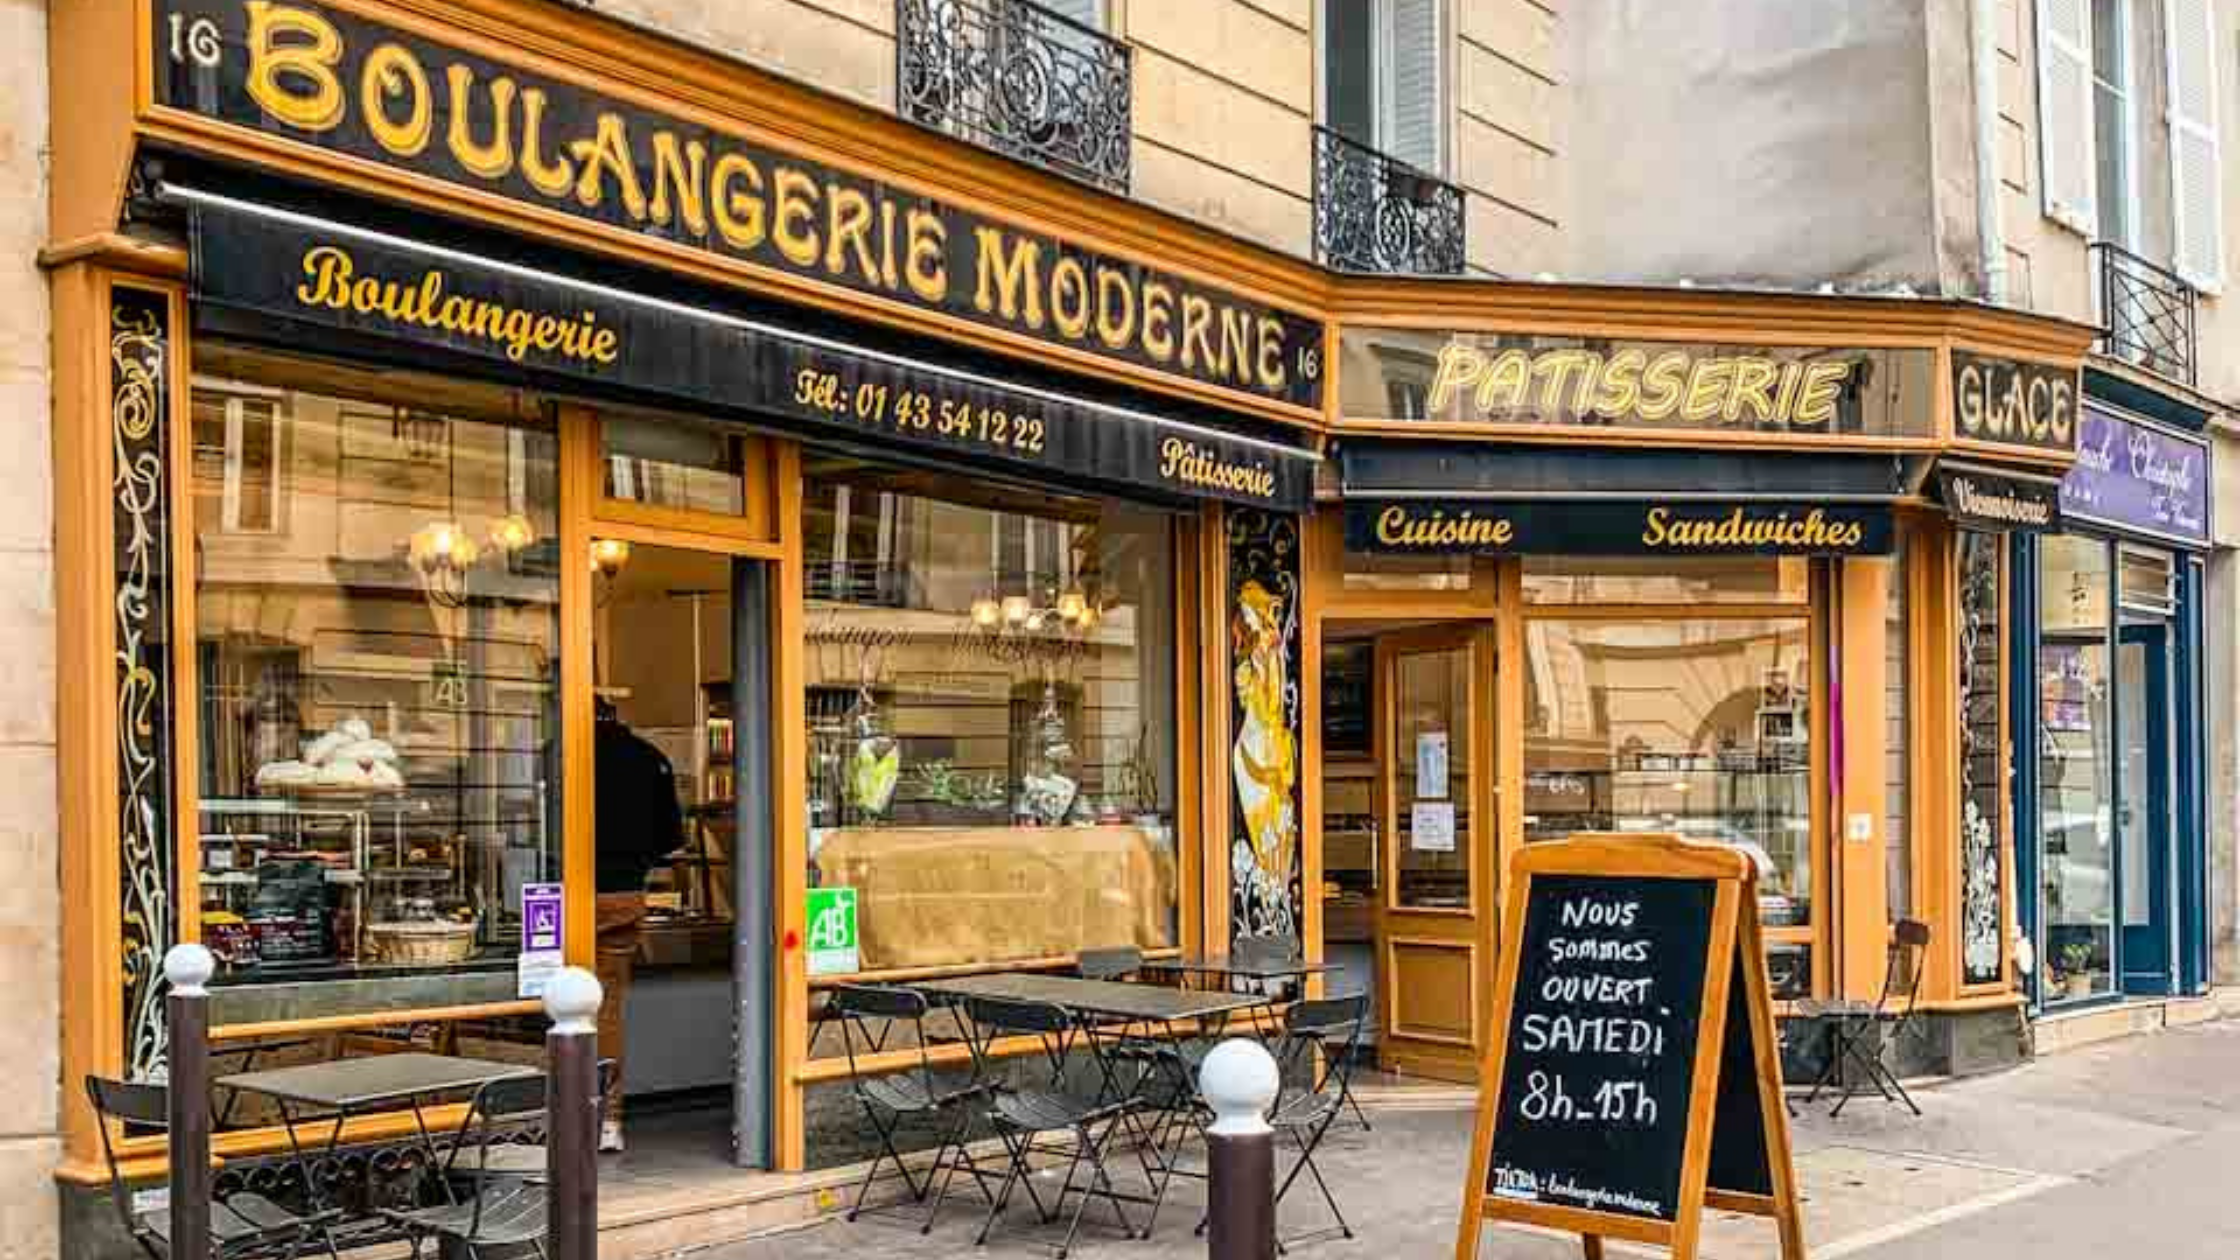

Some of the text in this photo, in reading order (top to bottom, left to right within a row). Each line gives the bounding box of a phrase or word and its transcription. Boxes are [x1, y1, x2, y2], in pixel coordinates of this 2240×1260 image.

[169, 0, 1318, 391] 16 BOULANGERIE MODERNE 16
[297, 245, 617, 363] Boulangerie
[1429, 342, 1848, 423] PATISSERIE
[1959, 365, 2073, 442] GLACE
[855, 384, 888, 422] 01
[895, 390, 931, 429] 43
[937, 400, 971, 437] 54
[979, 406, 1007, 443] 12
[1012, 414, 1044, 452] 22
[1160, 437, 1275, 497] Pâtisserie
[1377, 505, 1514, 545] Cuisine
[1641, 506, 1863, 545] Sandwiches
[808, 907, 848, 946] AB
[1542, 974, 1654, 1005] OUVERT
